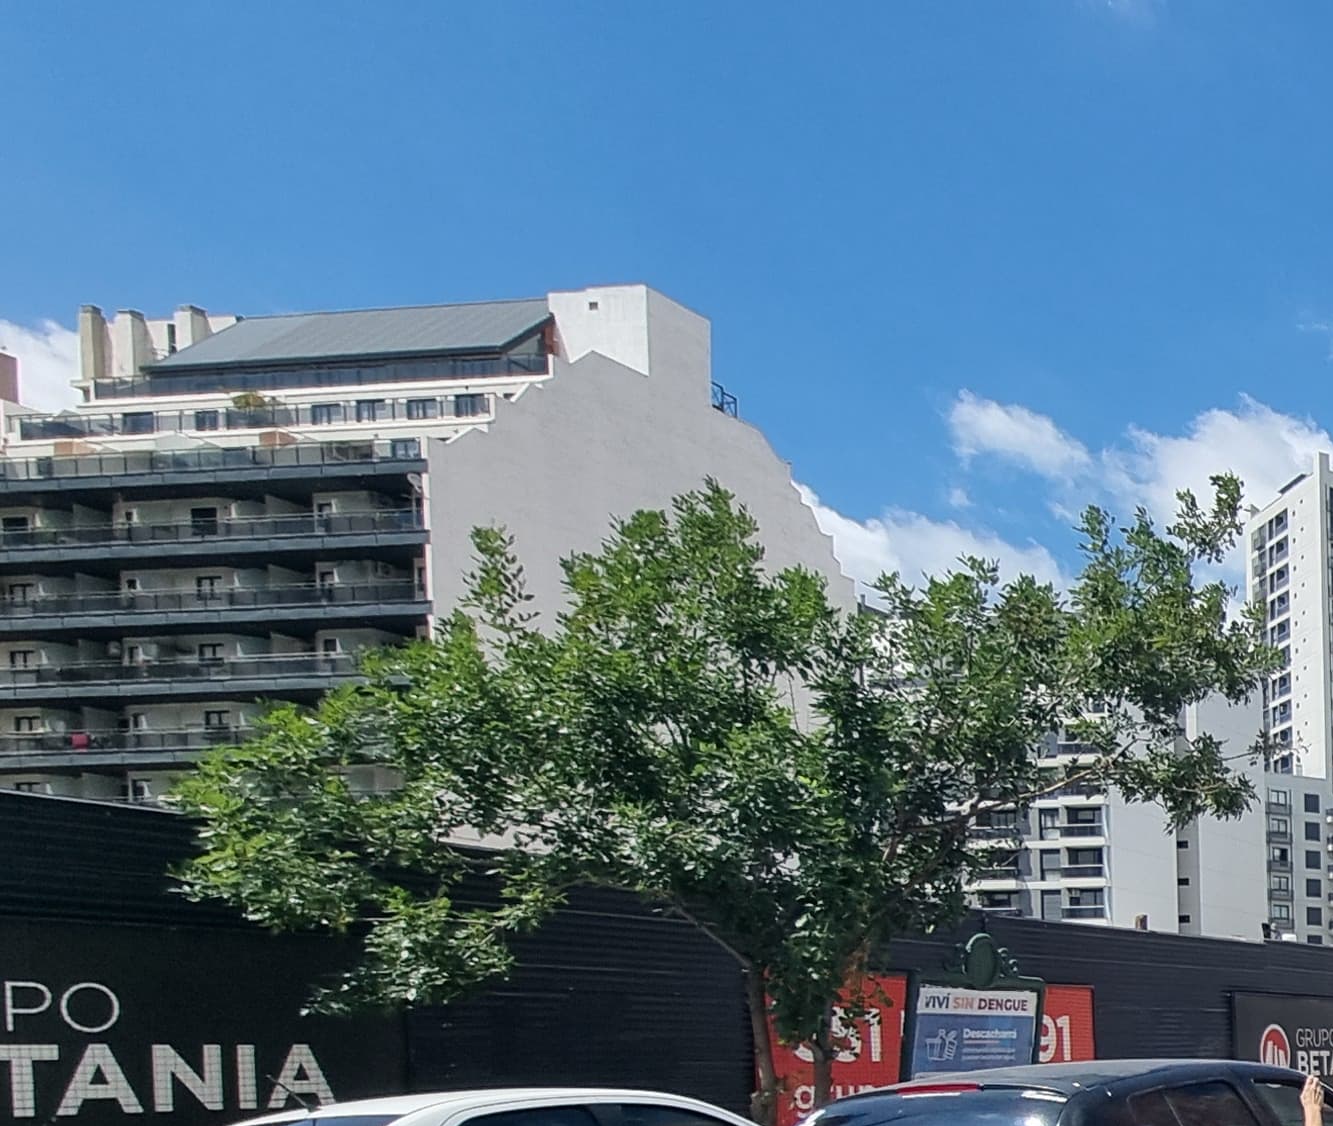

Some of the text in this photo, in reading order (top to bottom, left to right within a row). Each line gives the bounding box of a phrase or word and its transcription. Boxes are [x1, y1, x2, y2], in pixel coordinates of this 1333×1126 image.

[924, 992, 1028, 1012] VIVÍ SIN DENGUE
[0, 1043, 337, 1118] TANIA
